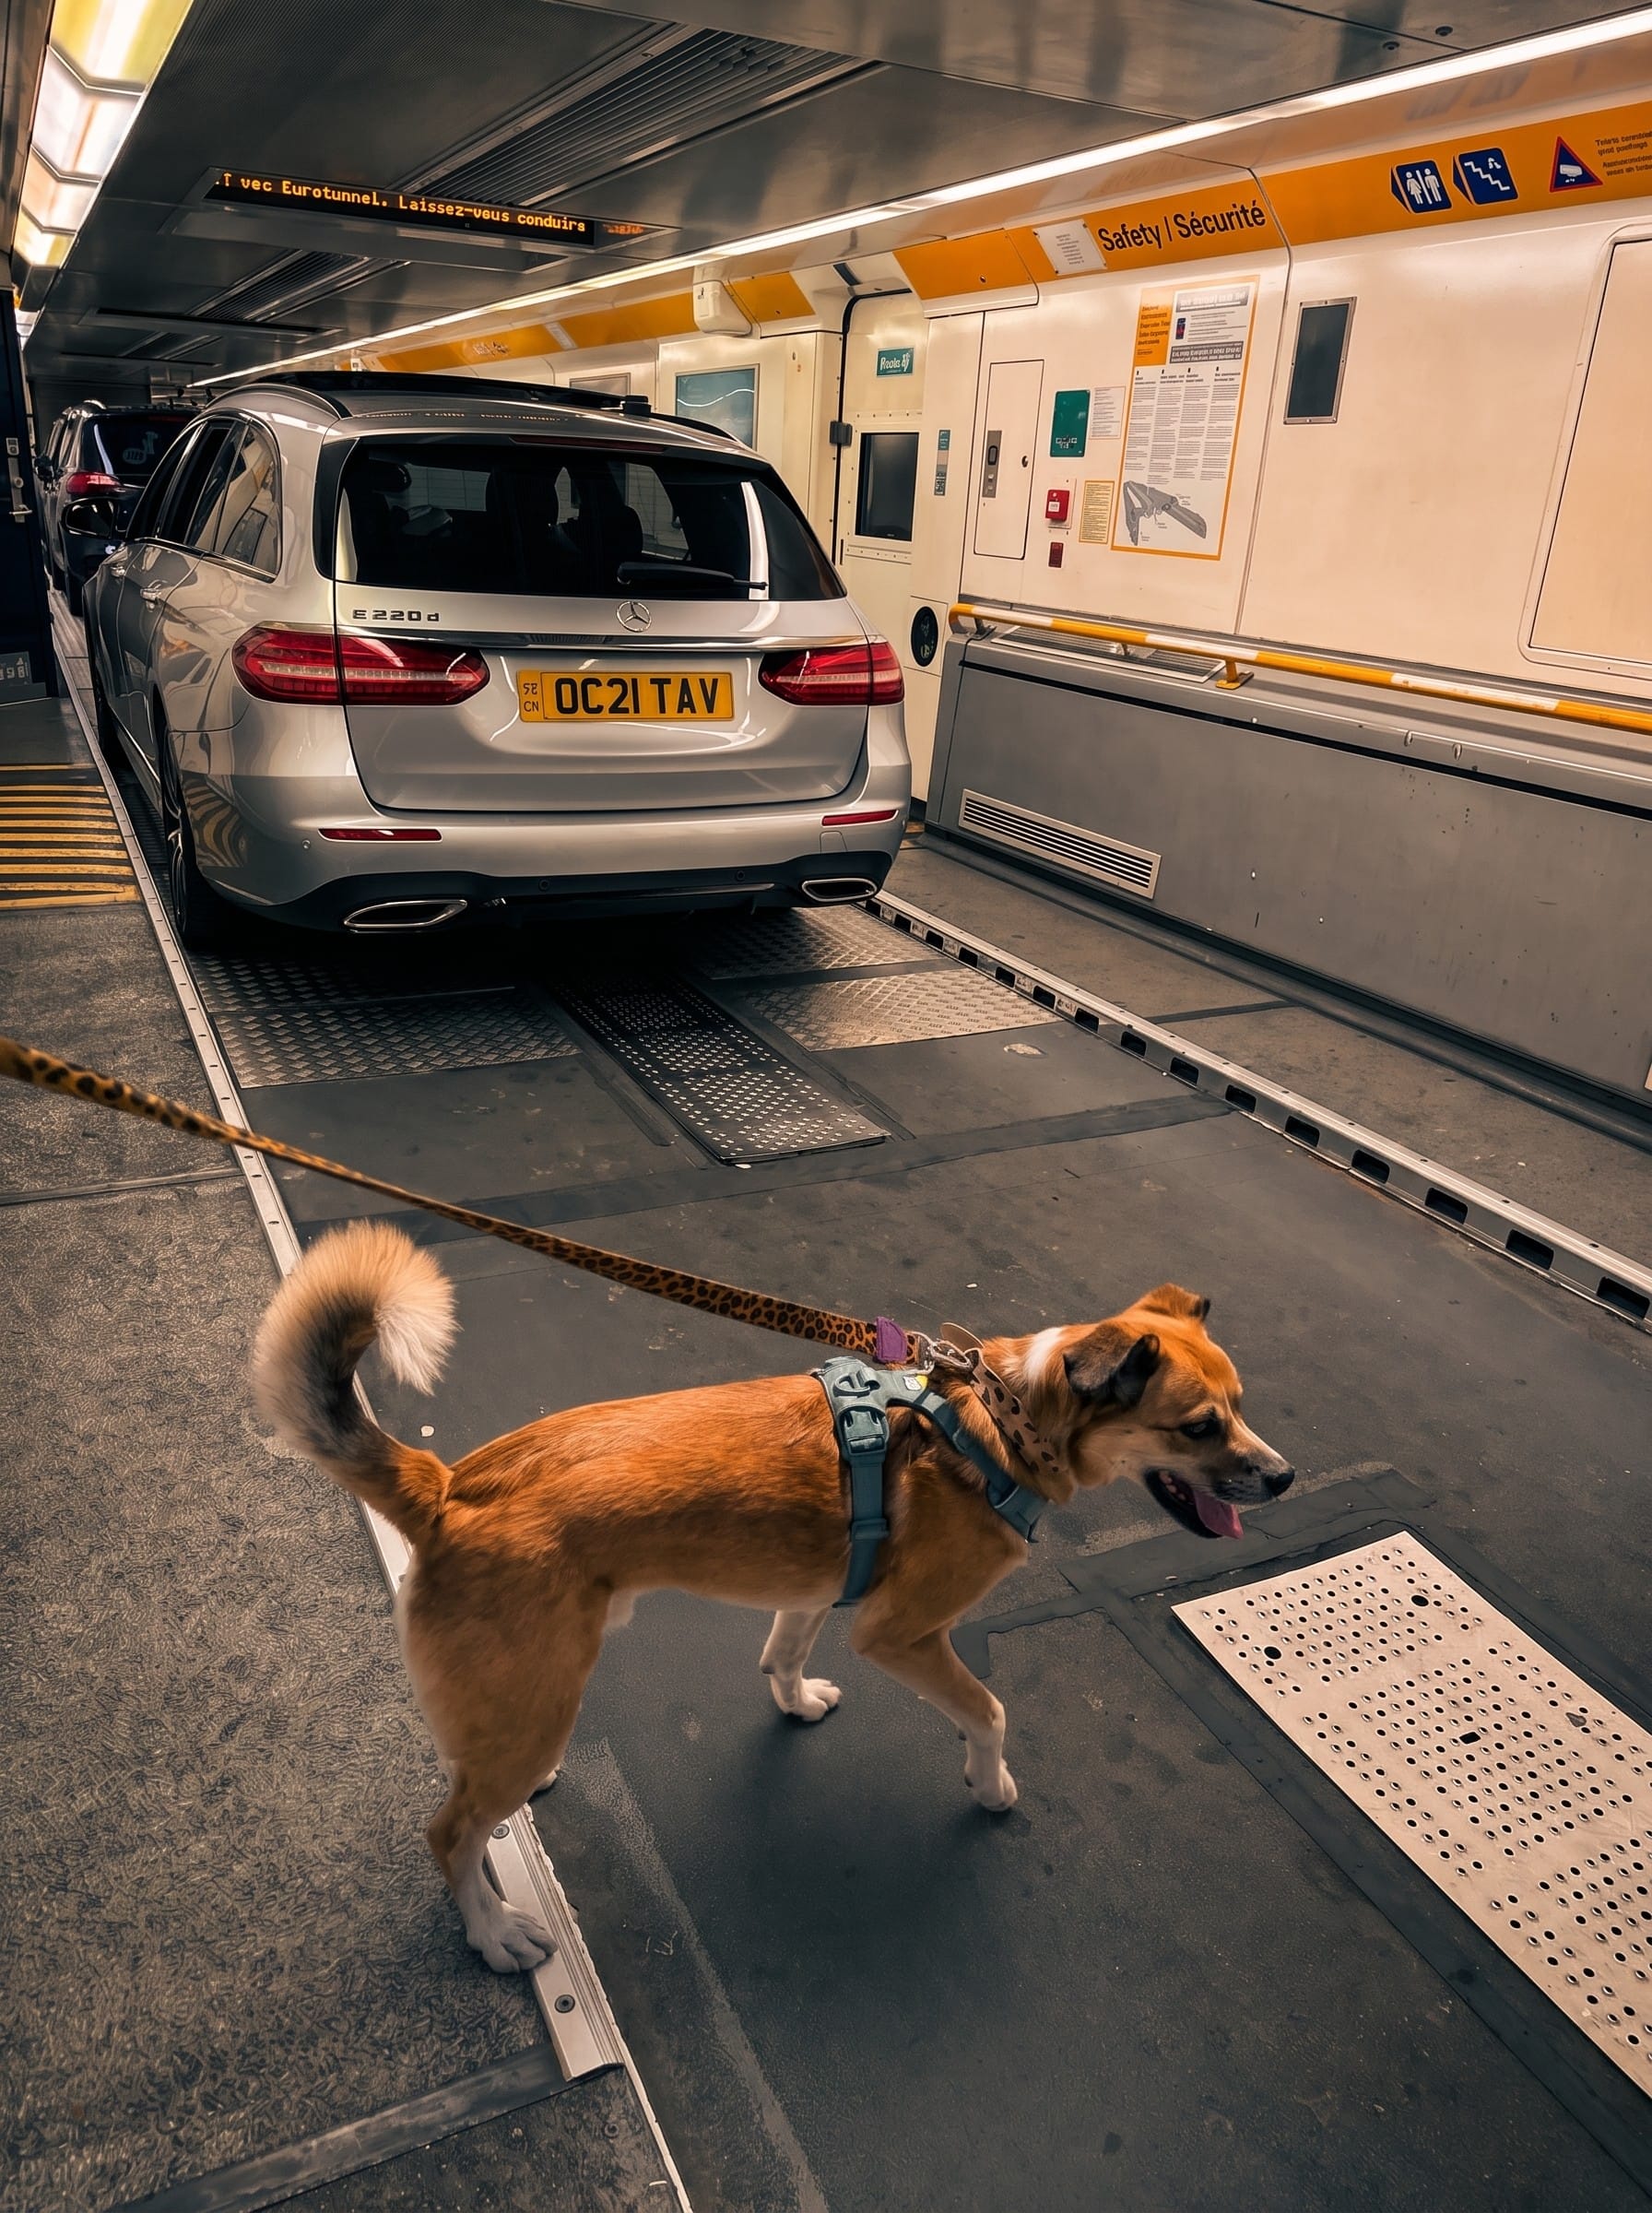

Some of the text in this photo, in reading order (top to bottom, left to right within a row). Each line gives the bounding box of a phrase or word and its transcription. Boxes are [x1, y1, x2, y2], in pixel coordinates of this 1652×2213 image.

[282, 180, 388, 207] Eurotunnel.
[1097, 222, 1162, 251] Safety
[1174, 199, 1267, 240] Sécurité
[555, 677, 719, 715] OC21 TAV
